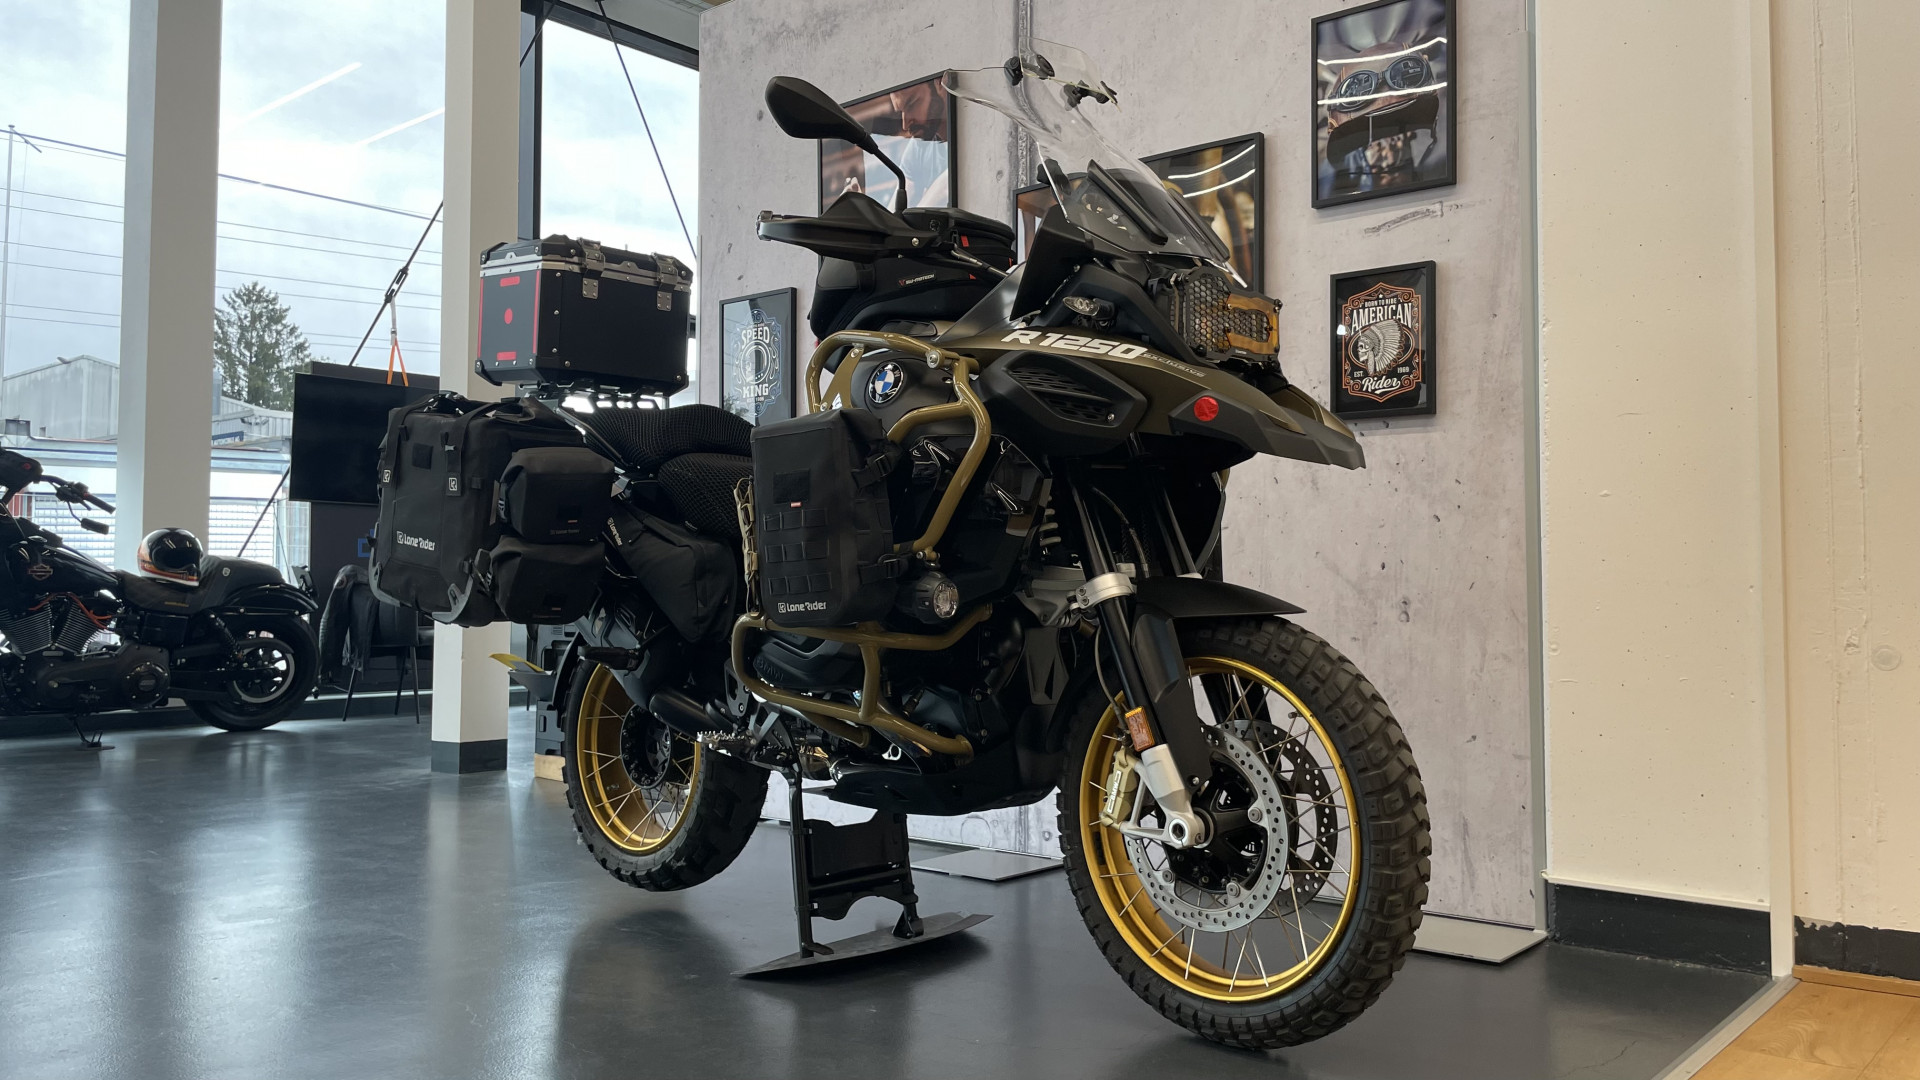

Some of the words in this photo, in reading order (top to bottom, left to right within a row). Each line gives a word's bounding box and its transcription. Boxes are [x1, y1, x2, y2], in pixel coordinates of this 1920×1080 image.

[1351, 302, 1412, 336] AMERICAN
[741, 326, 770, 350] SPEED
[1039, 332, 1149, 360] 1250
[742, 383, 769, 399] KING
[1362, 375, 1401, 394] Rider
